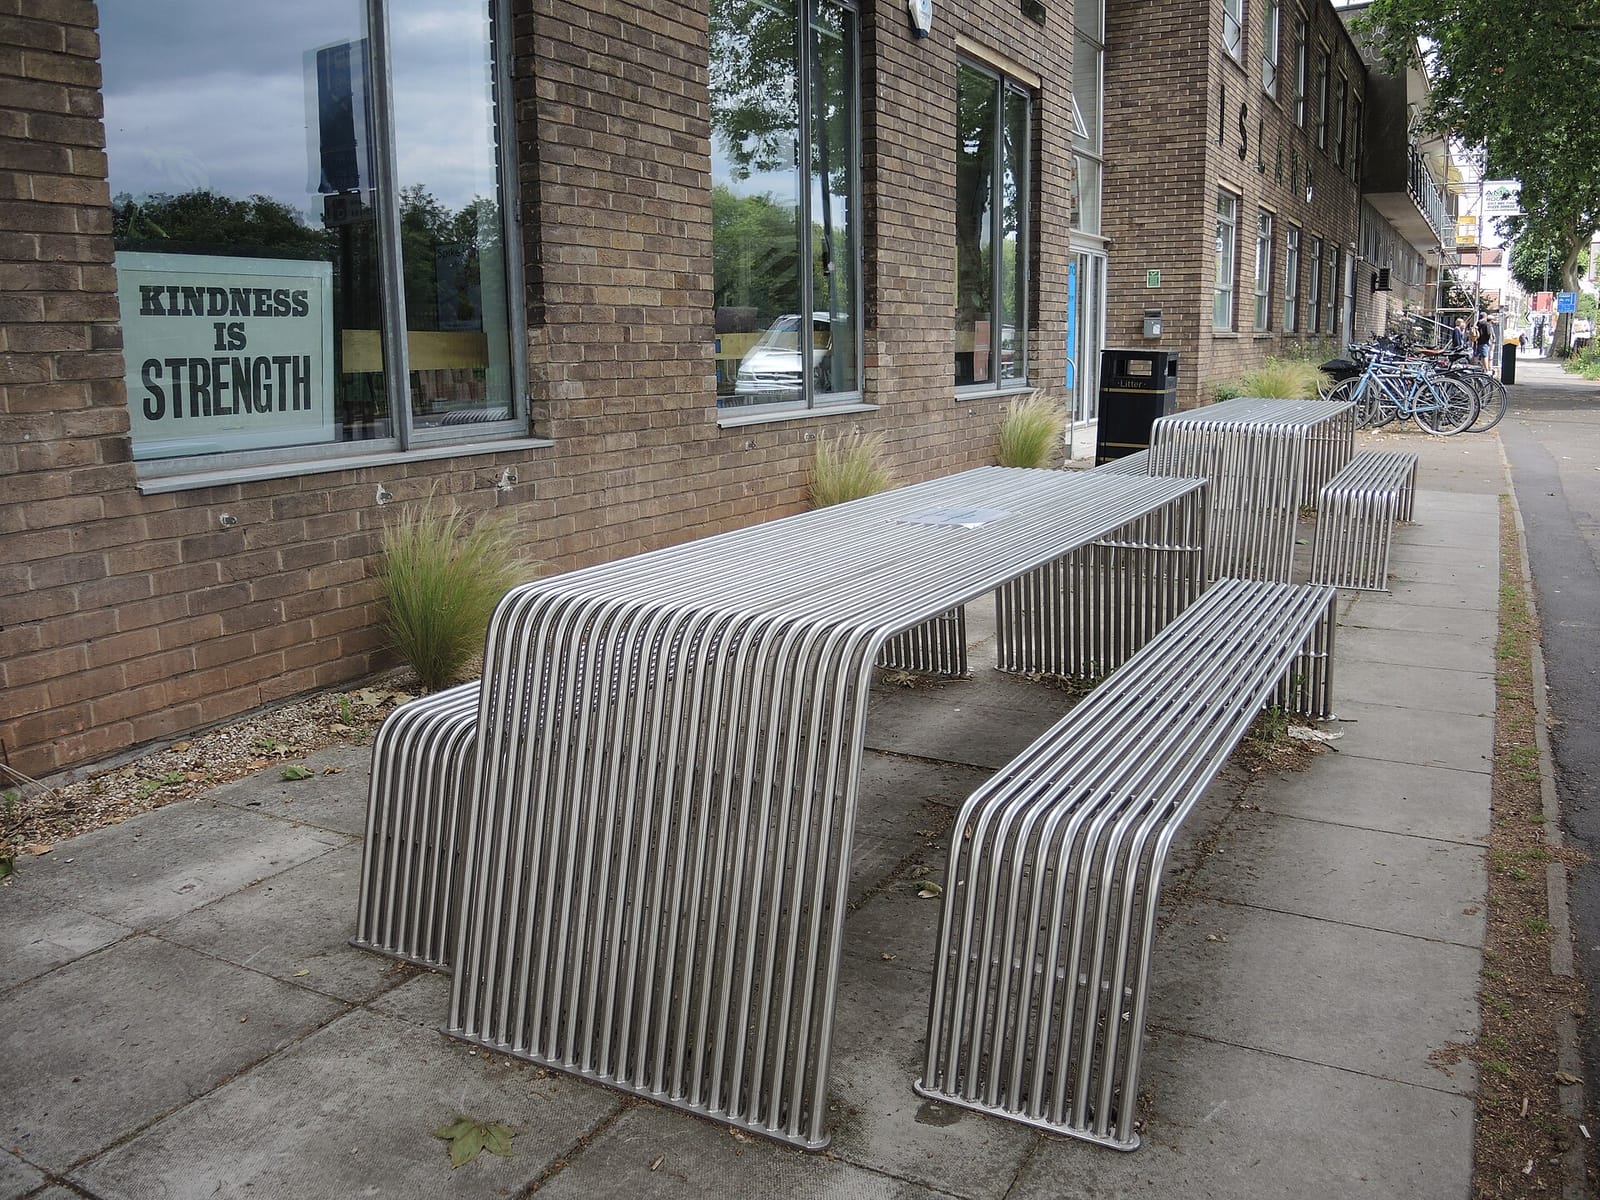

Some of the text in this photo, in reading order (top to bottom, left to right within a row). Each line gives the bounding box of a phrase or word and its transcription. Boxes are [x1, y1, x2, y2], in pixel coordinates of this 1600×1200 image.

[139, 285, 309, 317] KINDNESS
[213, 322, 247, 351] IS
[141, 355, 311, 421] STRENGTH
[1120, 379, 1143, 389] Litter
